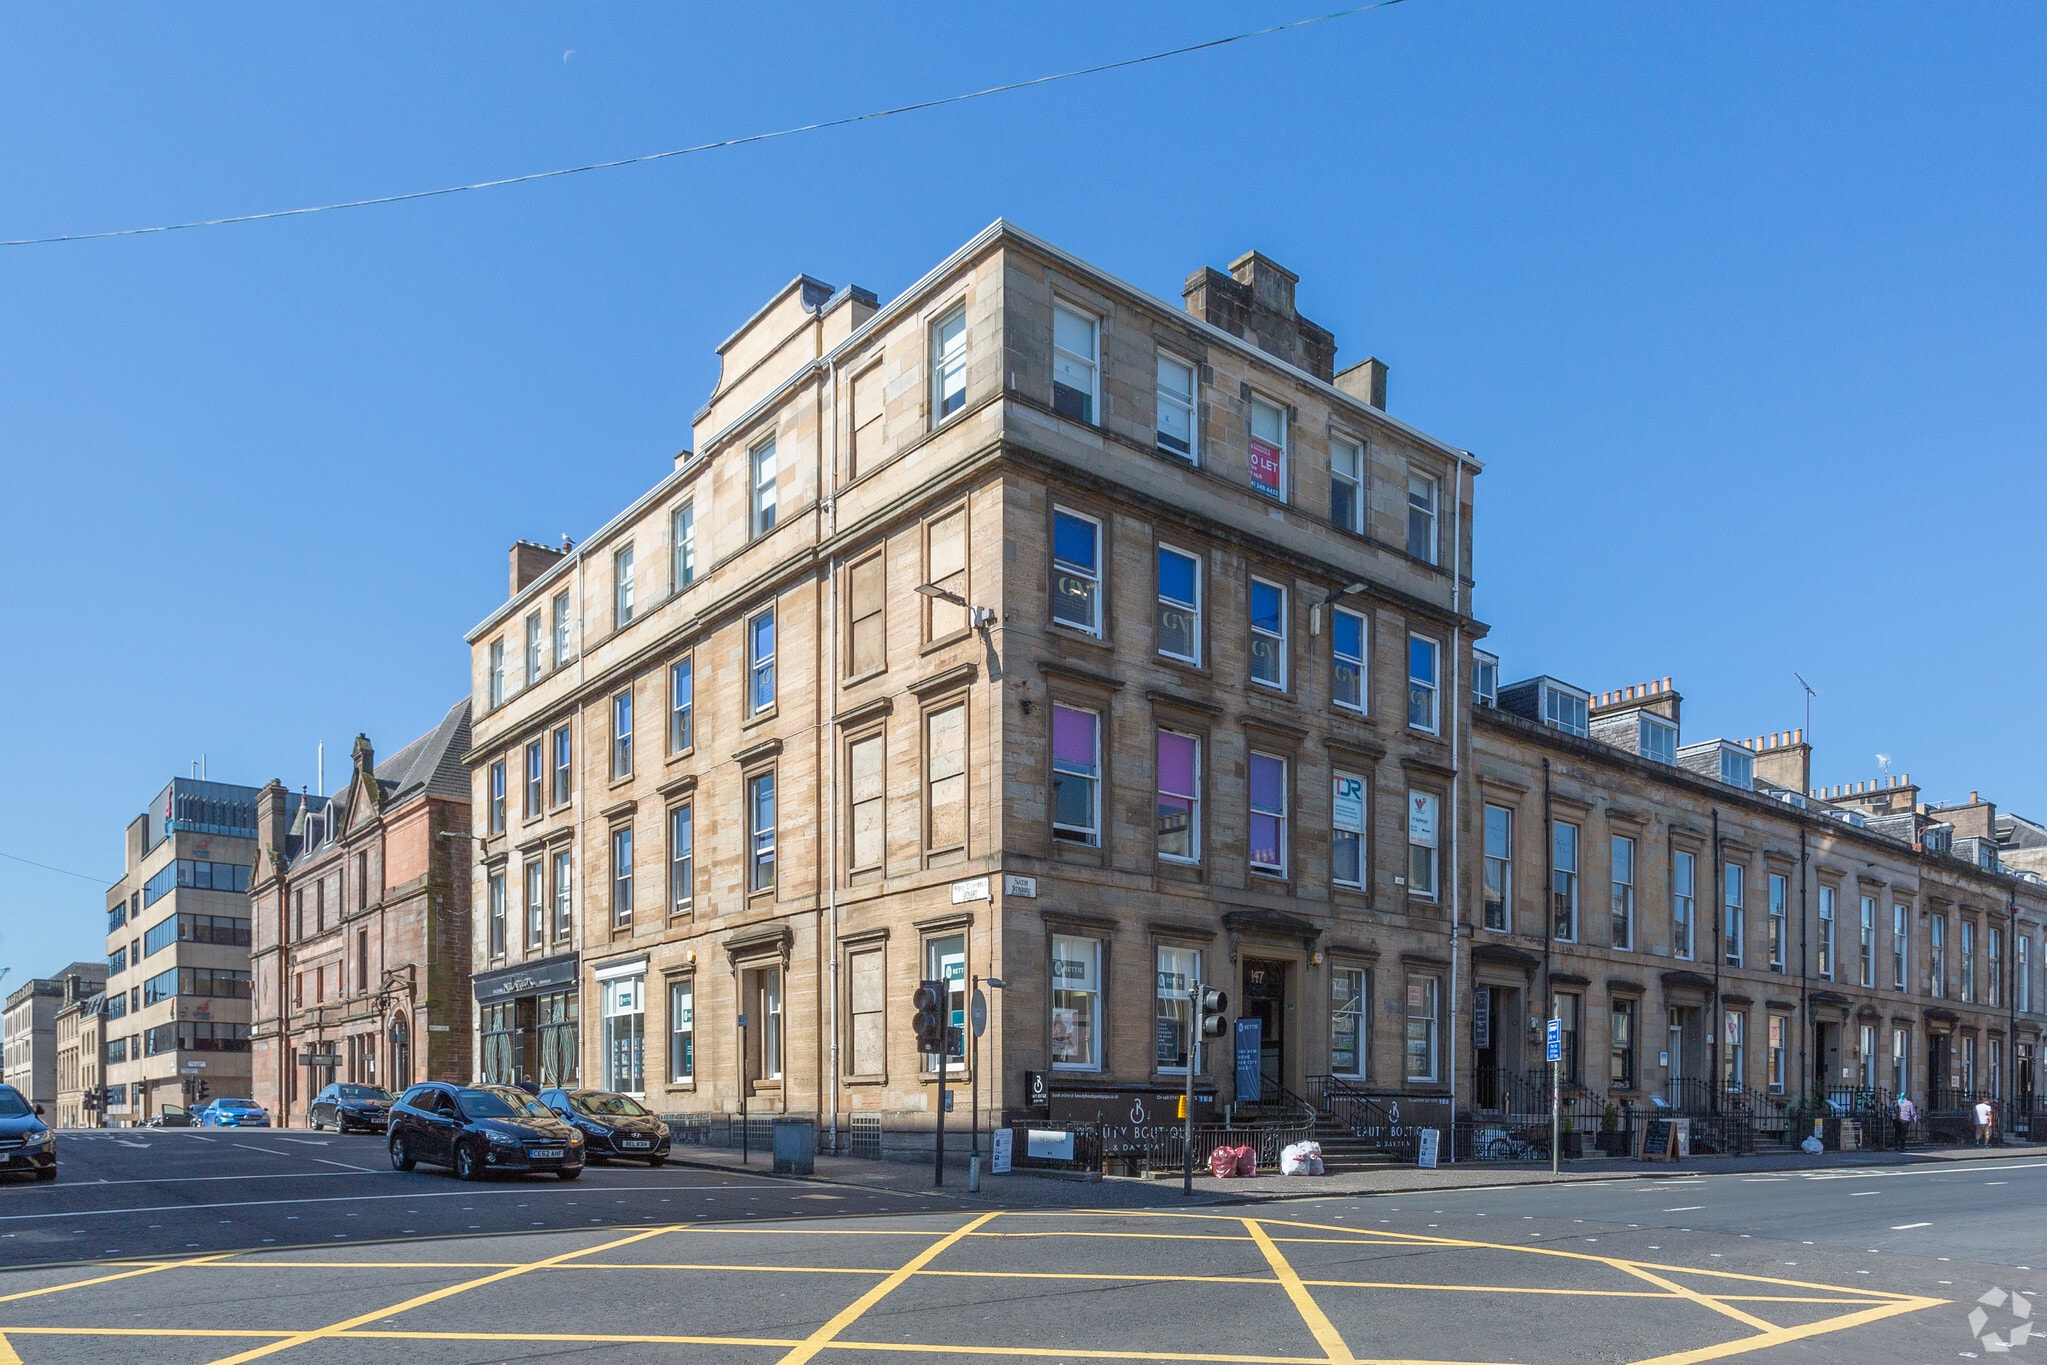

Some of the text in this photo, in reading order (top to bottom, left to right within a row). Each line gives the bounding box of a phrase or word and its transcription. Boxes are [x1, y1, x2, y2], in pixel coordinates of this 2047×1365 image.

[1261, 457, 1278, 473] LET
[952, 967, 964, 975] RETT
[1251, 970, 1264, 983] 147
[1134, 1126, 1190, 1139] BOUTQU
